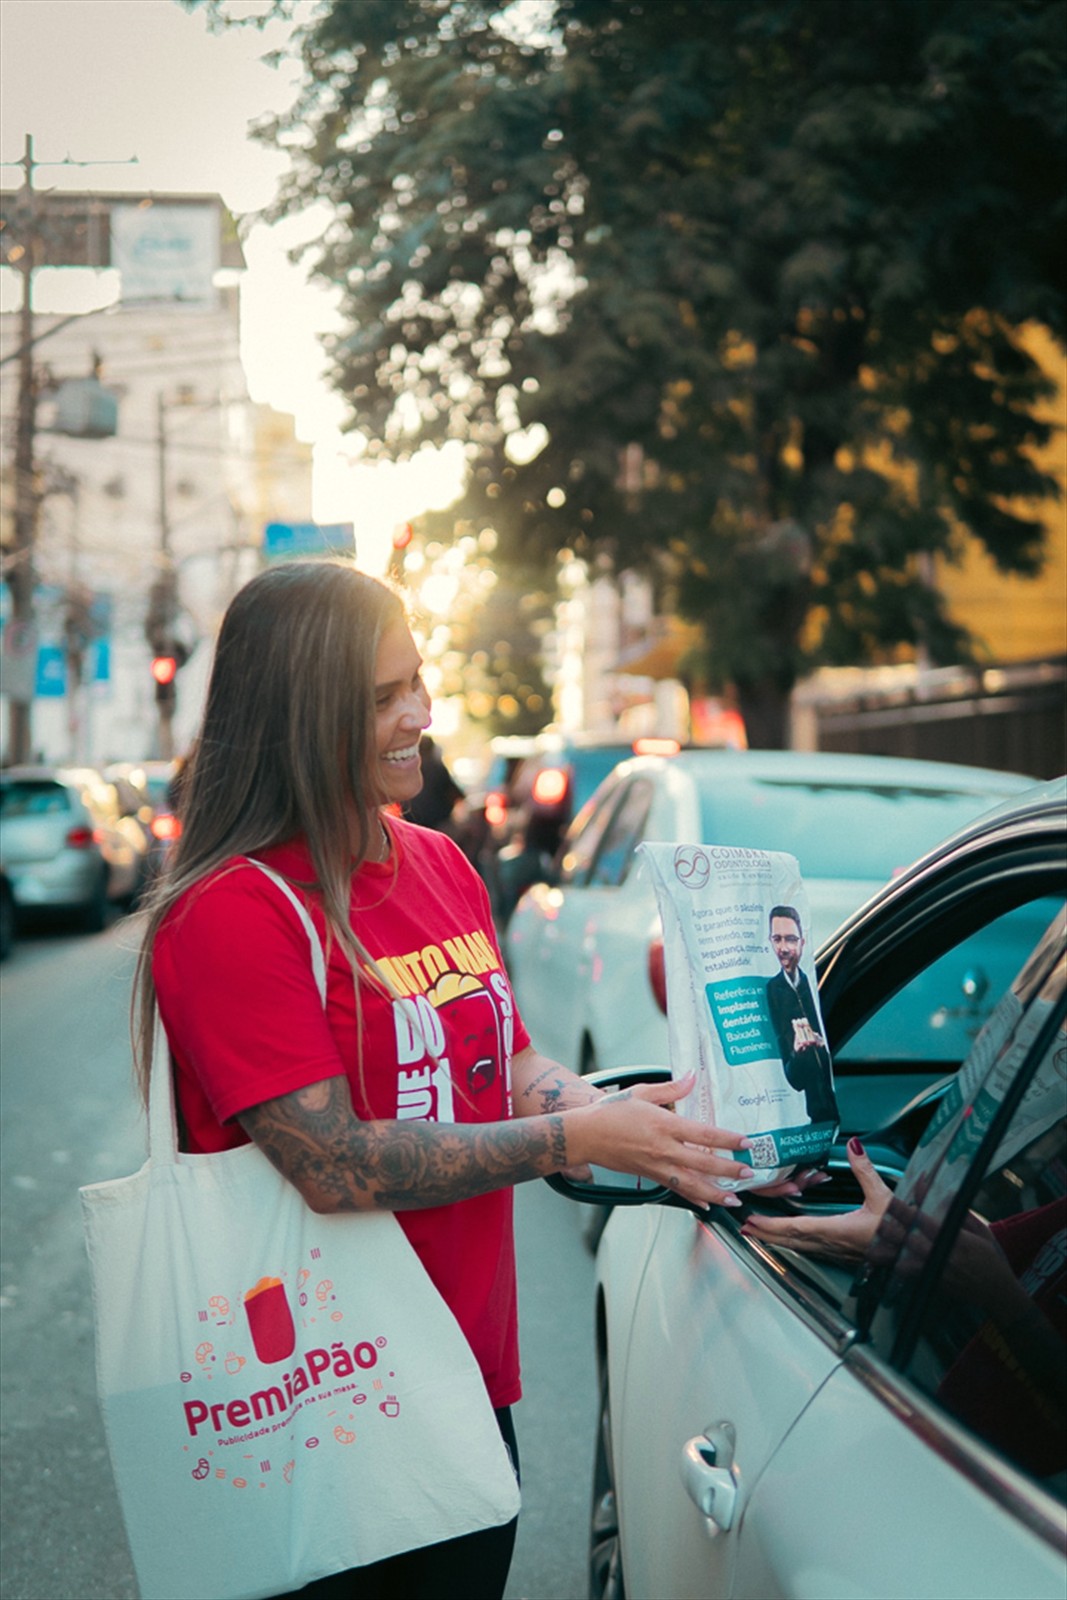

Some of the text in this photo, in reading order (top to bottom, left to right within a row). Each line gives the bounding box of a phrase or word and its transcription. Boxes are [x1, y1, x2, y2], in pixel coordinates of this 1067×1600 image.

[715, 905, 732, 915] que
[392, 994, 447, 1066] DO
[726, 1027, 761, 1043] Baixada
[396, 1064, 433, 1122] UE
[738, 1093, 766, 1107] Google
[217, 1427, 271, 1447] Publicidade
[304, 1395, 317, 1406] na
[318, 1390, 332, 1401] sua
